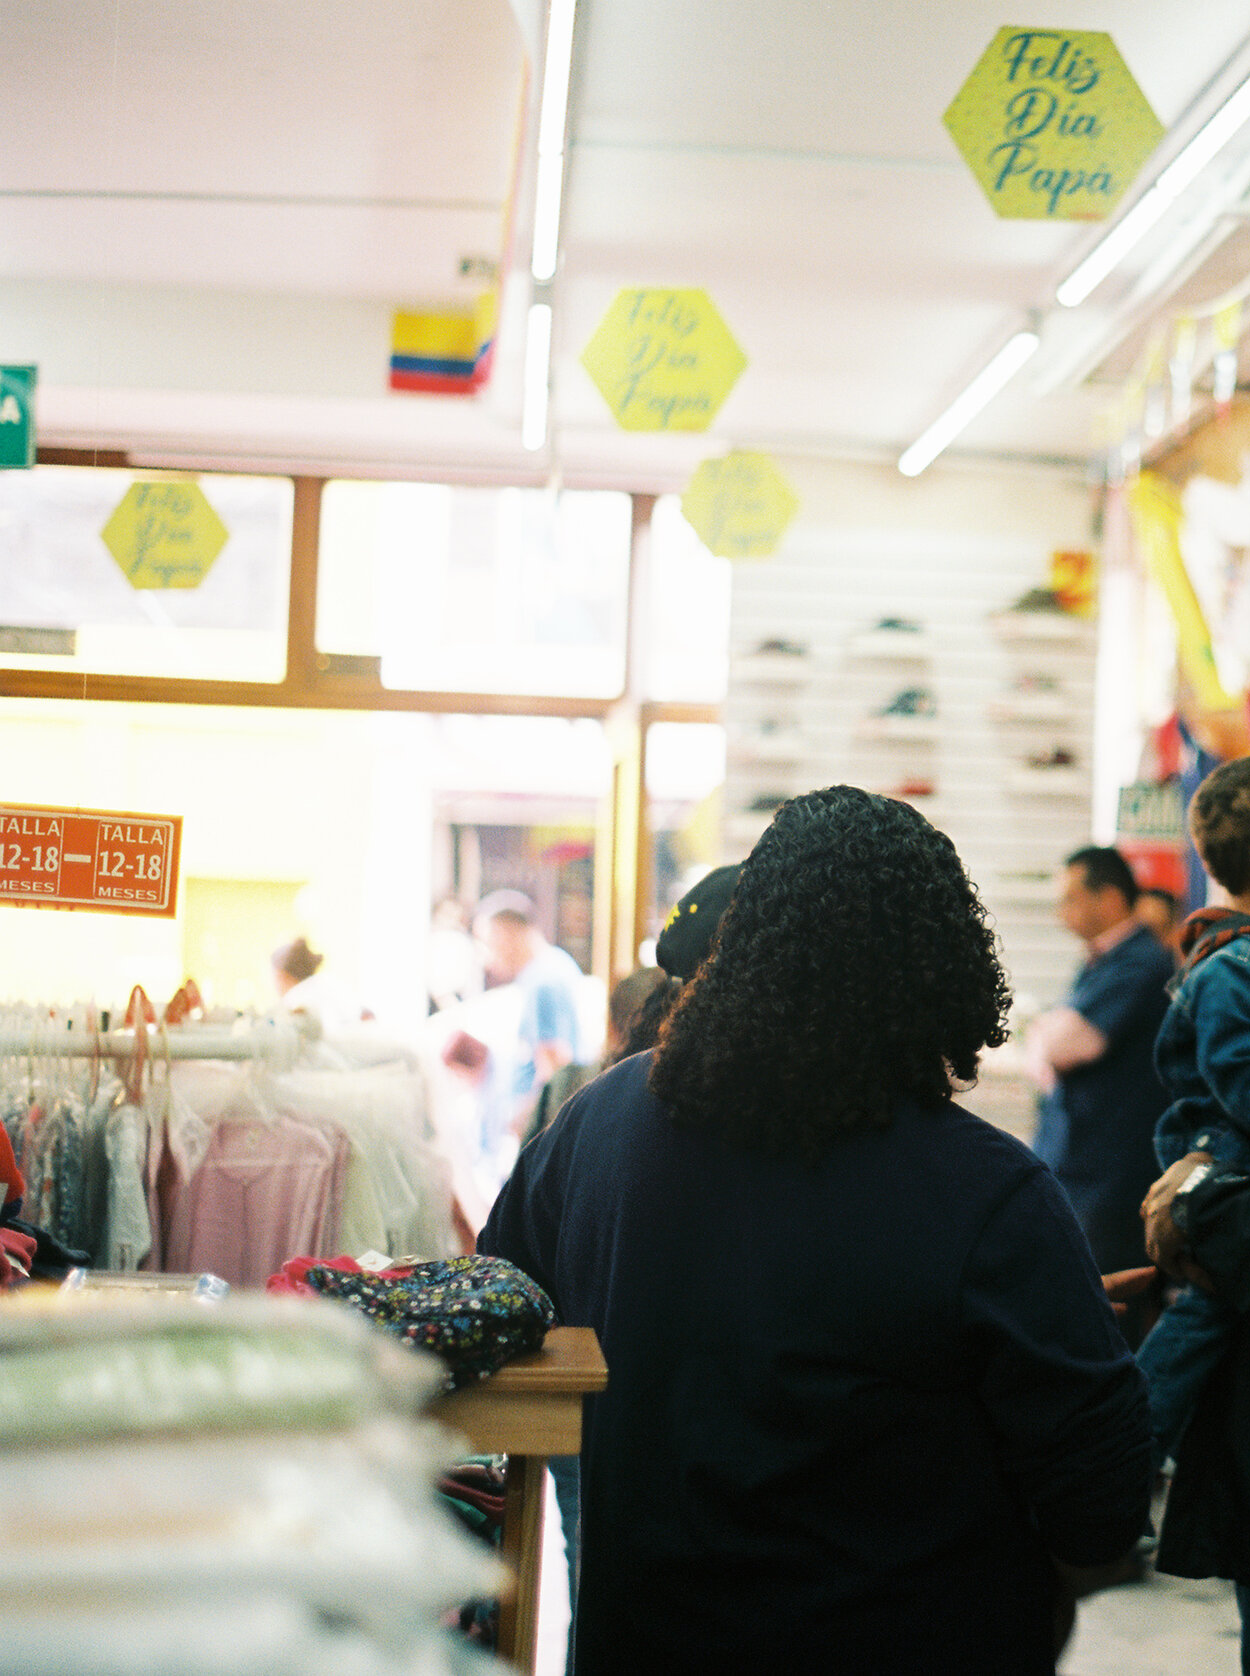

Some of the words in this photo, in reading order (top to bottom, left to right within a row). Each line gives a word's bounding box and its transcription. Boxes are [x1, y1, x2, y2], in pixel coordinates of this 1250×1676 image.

[1003, 31, 1101, 95] Feliz
[0, 816, 60, 836] TALLA
[101, 824, 164, 845] TALLA
[0, 843, 58, 872] 12-18
[98, 850, 162, 880] 12-18
[98, 886, 157, 901] MESES
